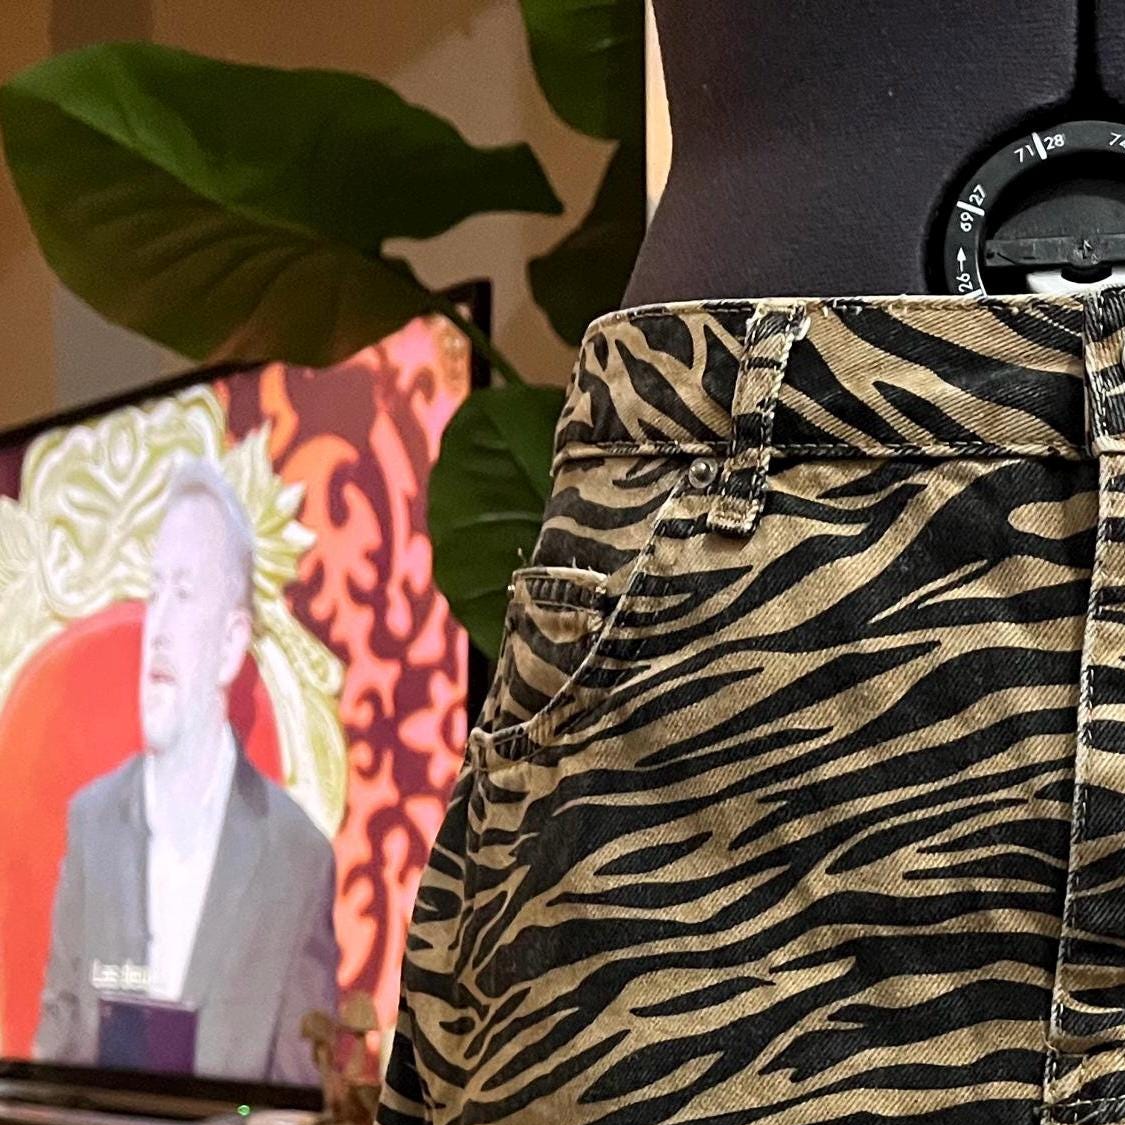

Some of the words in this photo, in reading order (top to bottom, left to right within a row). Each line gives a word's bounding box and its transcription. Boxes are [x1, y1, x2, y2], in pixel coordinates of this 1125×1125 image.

[1014, 144, 1034, 163] 71
[1043, 133, 1064, 150] 28
[960, 212, 974, 232] 69
[968, 184, 986, 206] 27
[955, 272, 974, 293] 26
